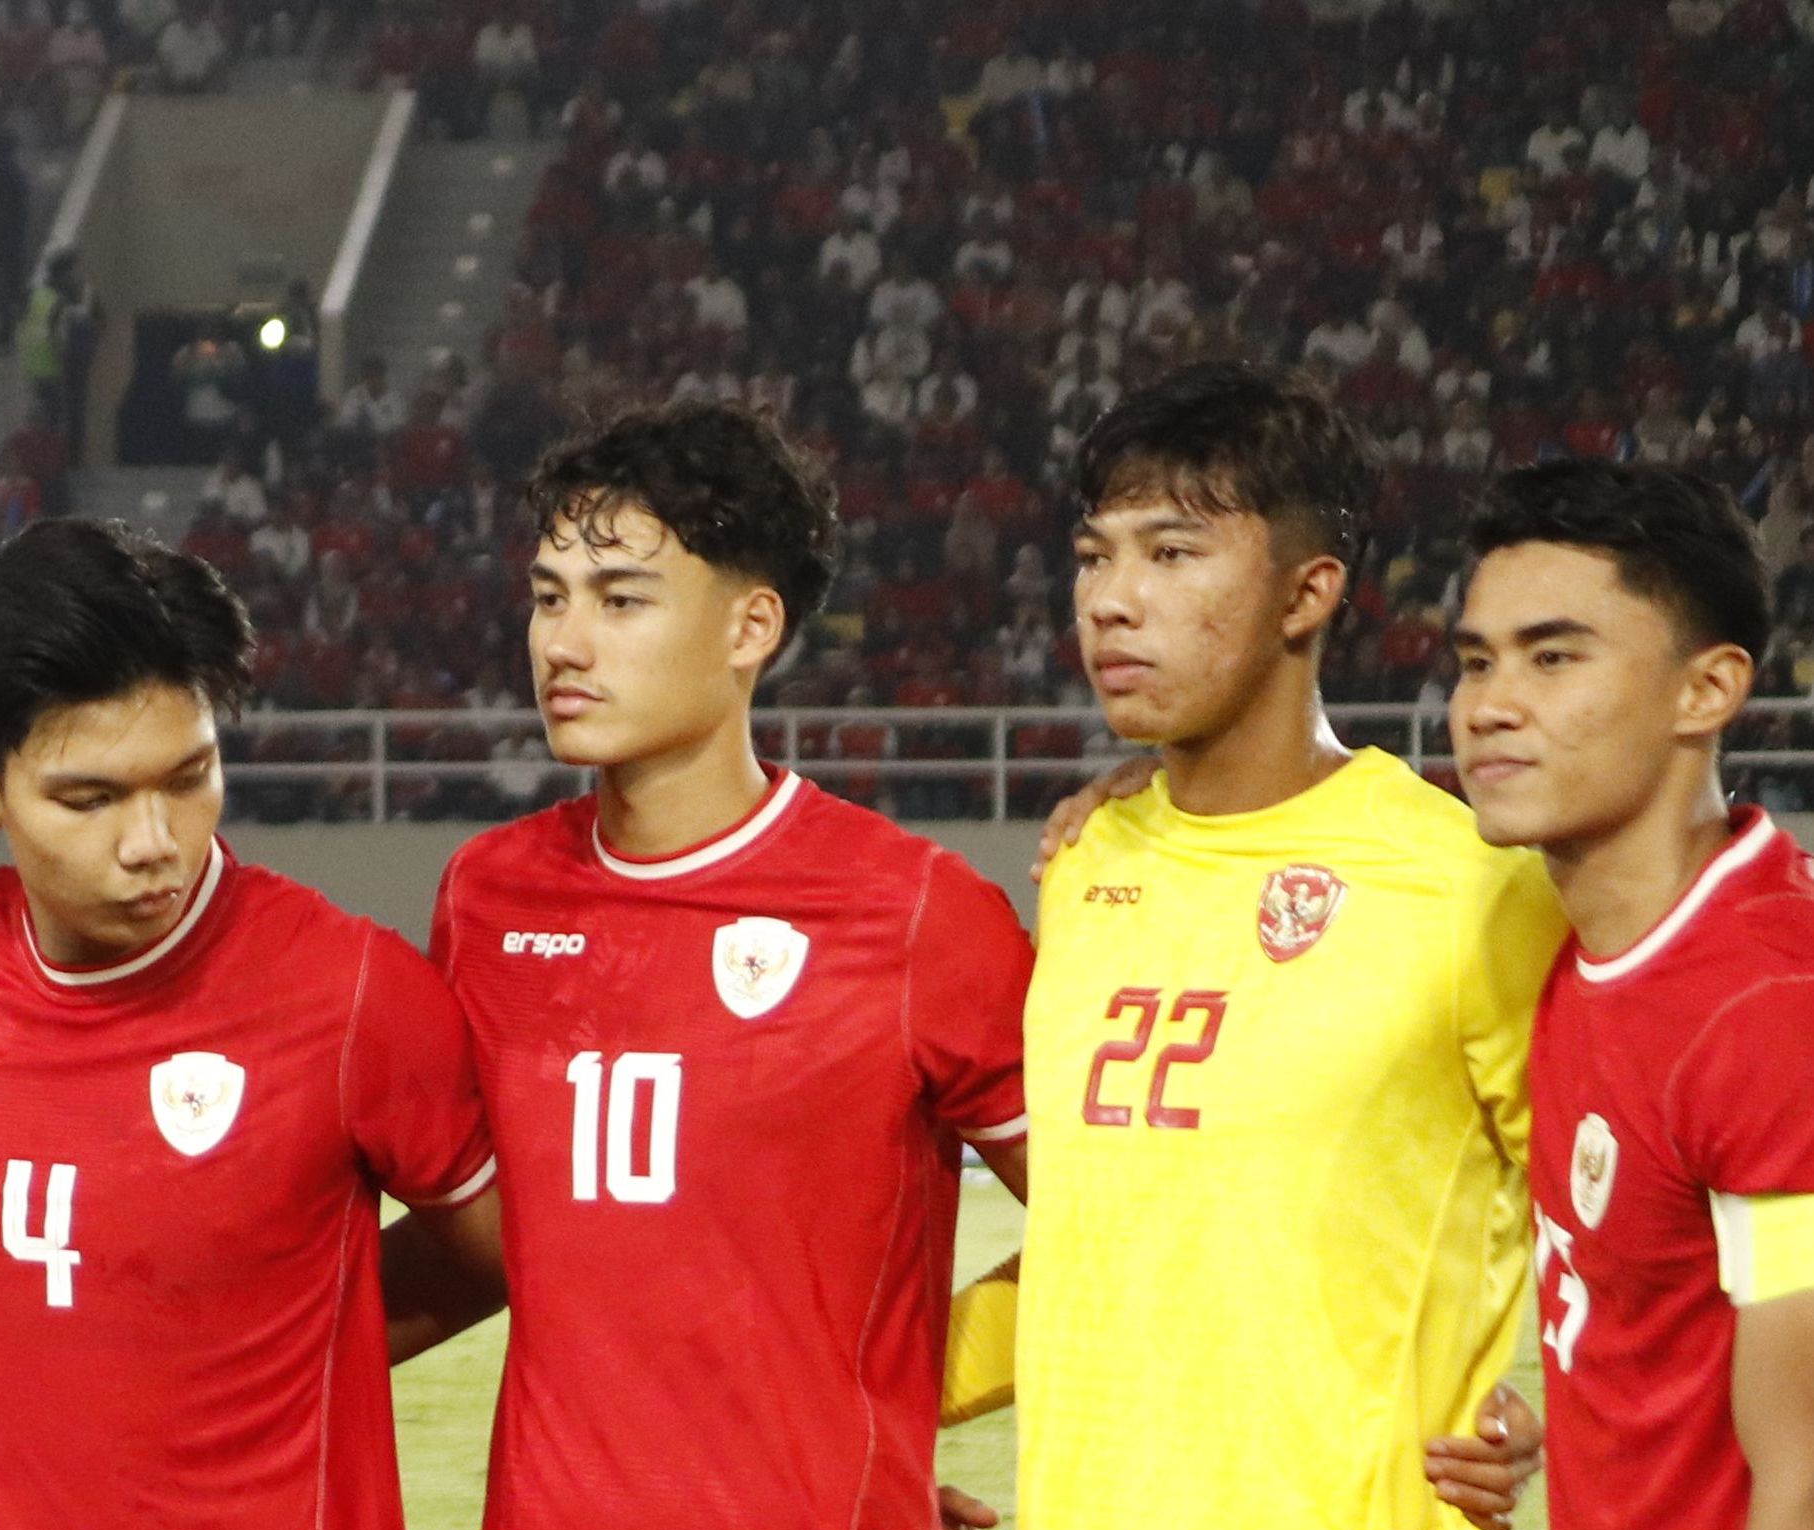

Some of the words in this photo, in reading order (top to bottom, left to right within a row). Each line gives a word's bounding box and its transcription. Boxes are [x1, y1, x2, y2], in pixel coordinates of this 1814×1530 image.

[503, 931, 586, 959] erspo
[1084, 885, 1141, 908] erspo
[566, 1050, 683, 1204] 10
[1081, 986, 1229, 1130] 22
[1, 1159, 81, 1308] 4
